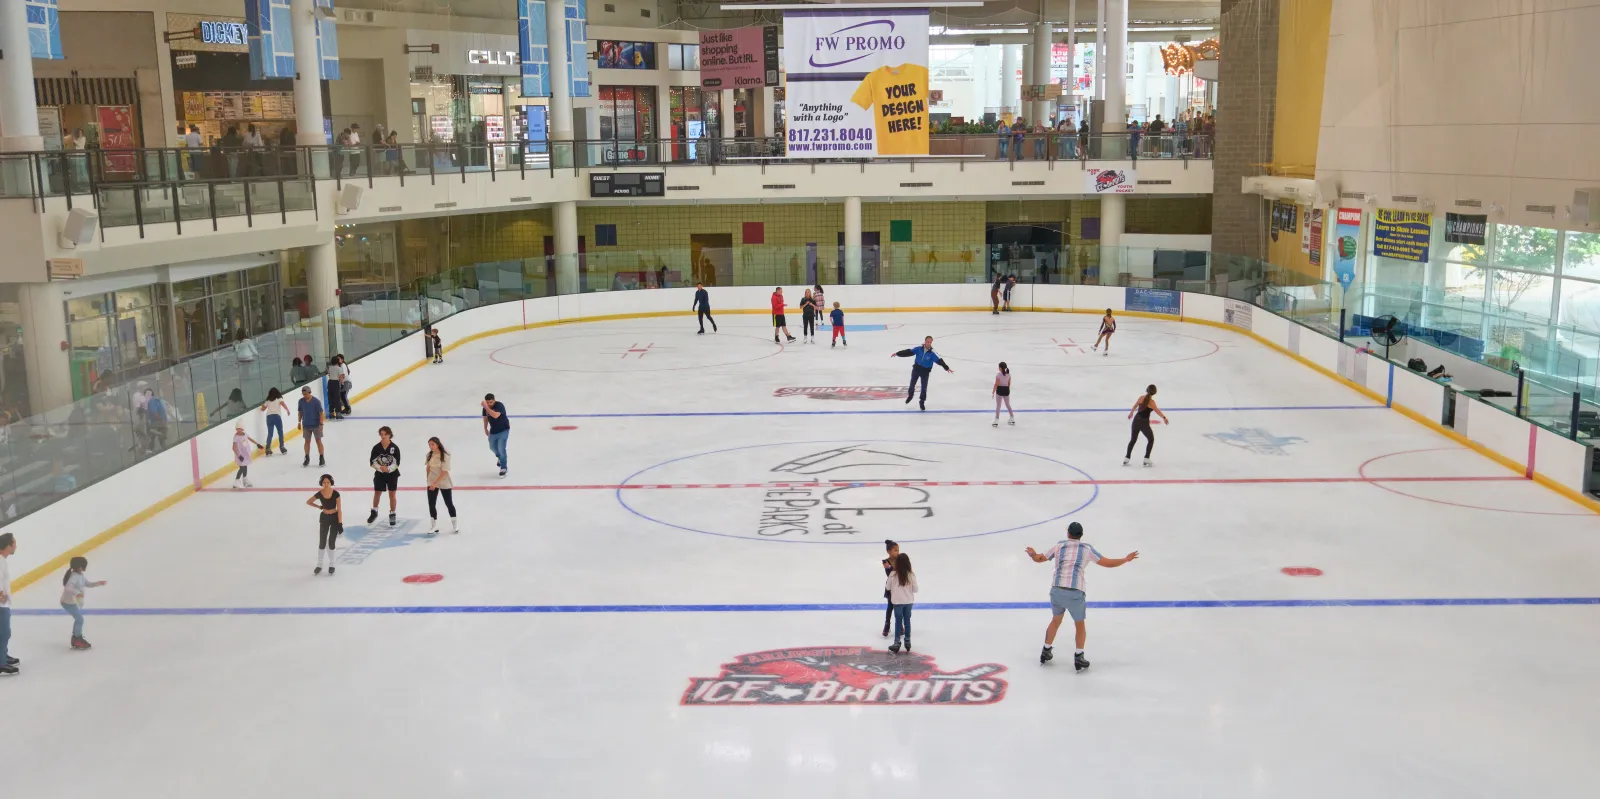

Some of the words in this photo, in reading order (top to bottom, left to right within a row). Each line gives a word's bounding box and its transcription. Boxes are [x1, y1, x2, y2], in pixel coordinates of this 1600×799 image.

[702, 34, 718, 44] Just
[720, 33, 733, 42] like
[816, 37, 839, 51] FW
[846, 36, 905, 51] PROMO
[702, 44, 738, 55] shopping
[702, 56, 727, 66] online.
[729, 55, 743, 64] But
[744, 54, 758, 63] IRL.
[735, 77, 763, 85] Klarna.
[885, 83, 917, 99] YOUR
[881, 100, 924, 117] DESIGN
[793, 113, 813, 122] with
[888, 117, 922, 133] HERE!
[788, 128, 873, 141] 817.231.8040
[788, 141, 873, 151] www.fwpromo.com
[824, 479, 934, 520] ICE
[757, 499, 821, 536] PARKS
[823, 523, 861, 535] at
[696, 680, 771, 701] ICE
[808, 680, 994, 702] BANDITS
